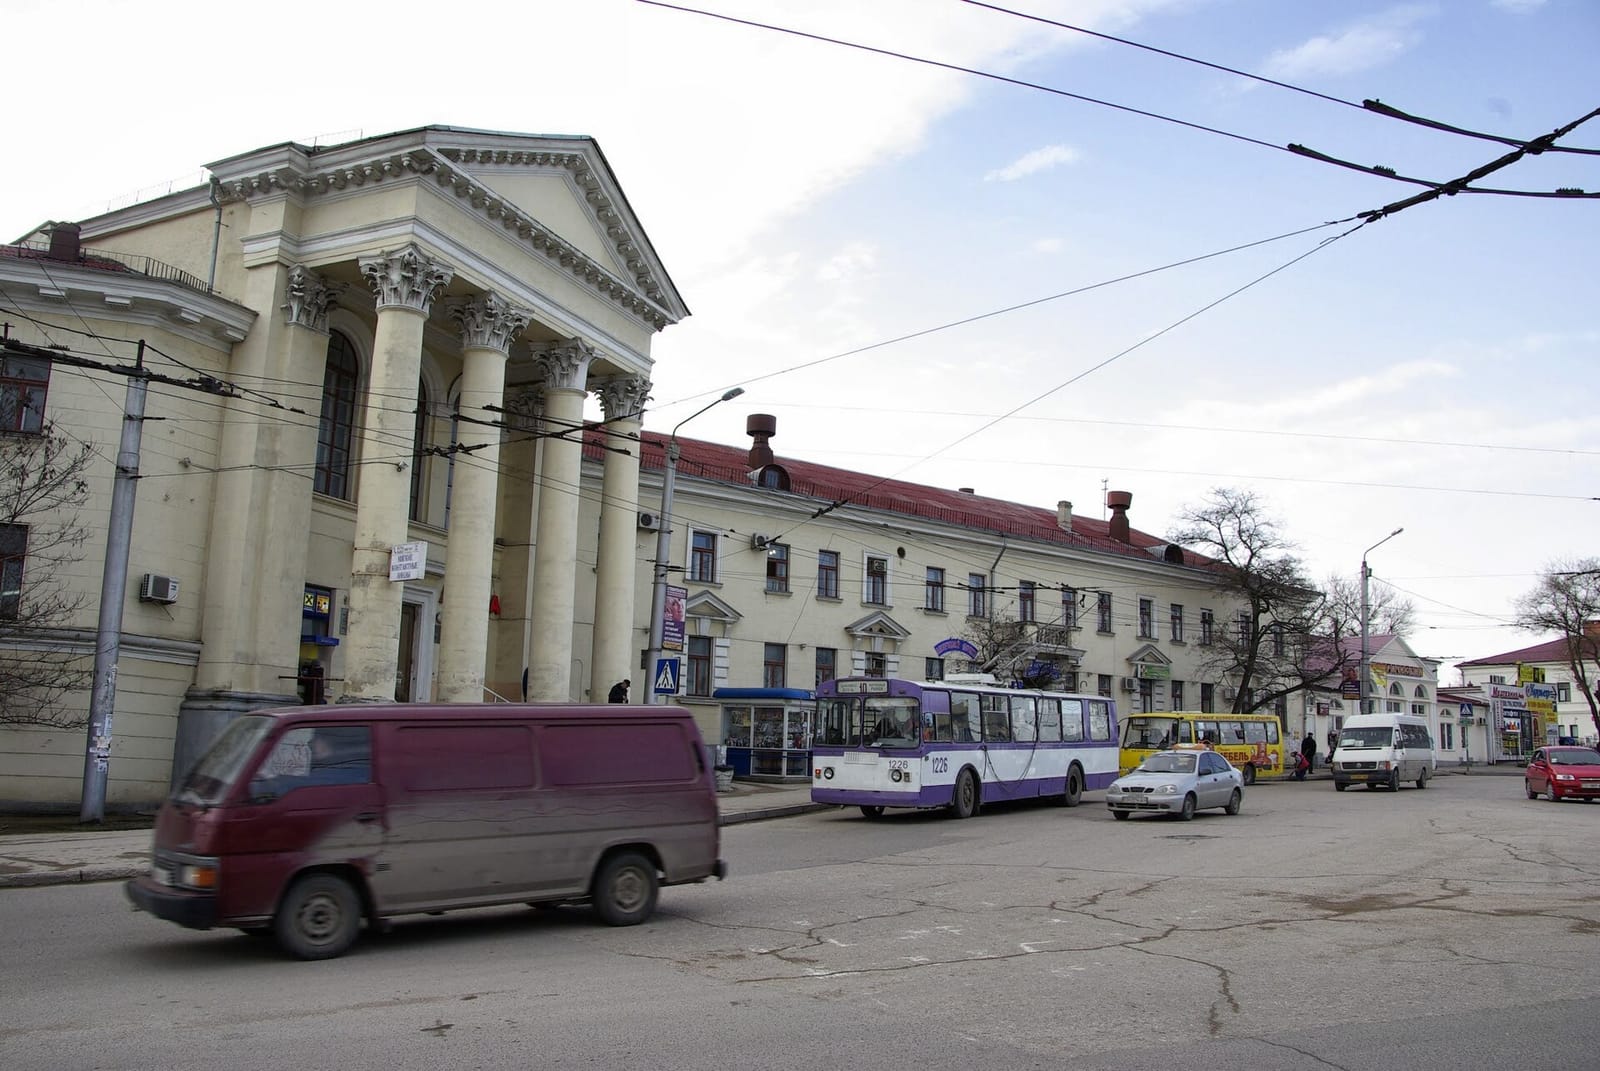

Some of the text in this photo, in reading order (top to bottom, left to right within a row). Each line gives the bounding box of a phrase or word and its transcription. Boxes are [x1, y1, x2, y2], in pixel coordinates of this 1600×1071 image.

[1220, 752, 1249, 761] ЕБЕЛЬ
[888, 760, 908, 769] 1226
[932, 757, 948, 773] 1226
